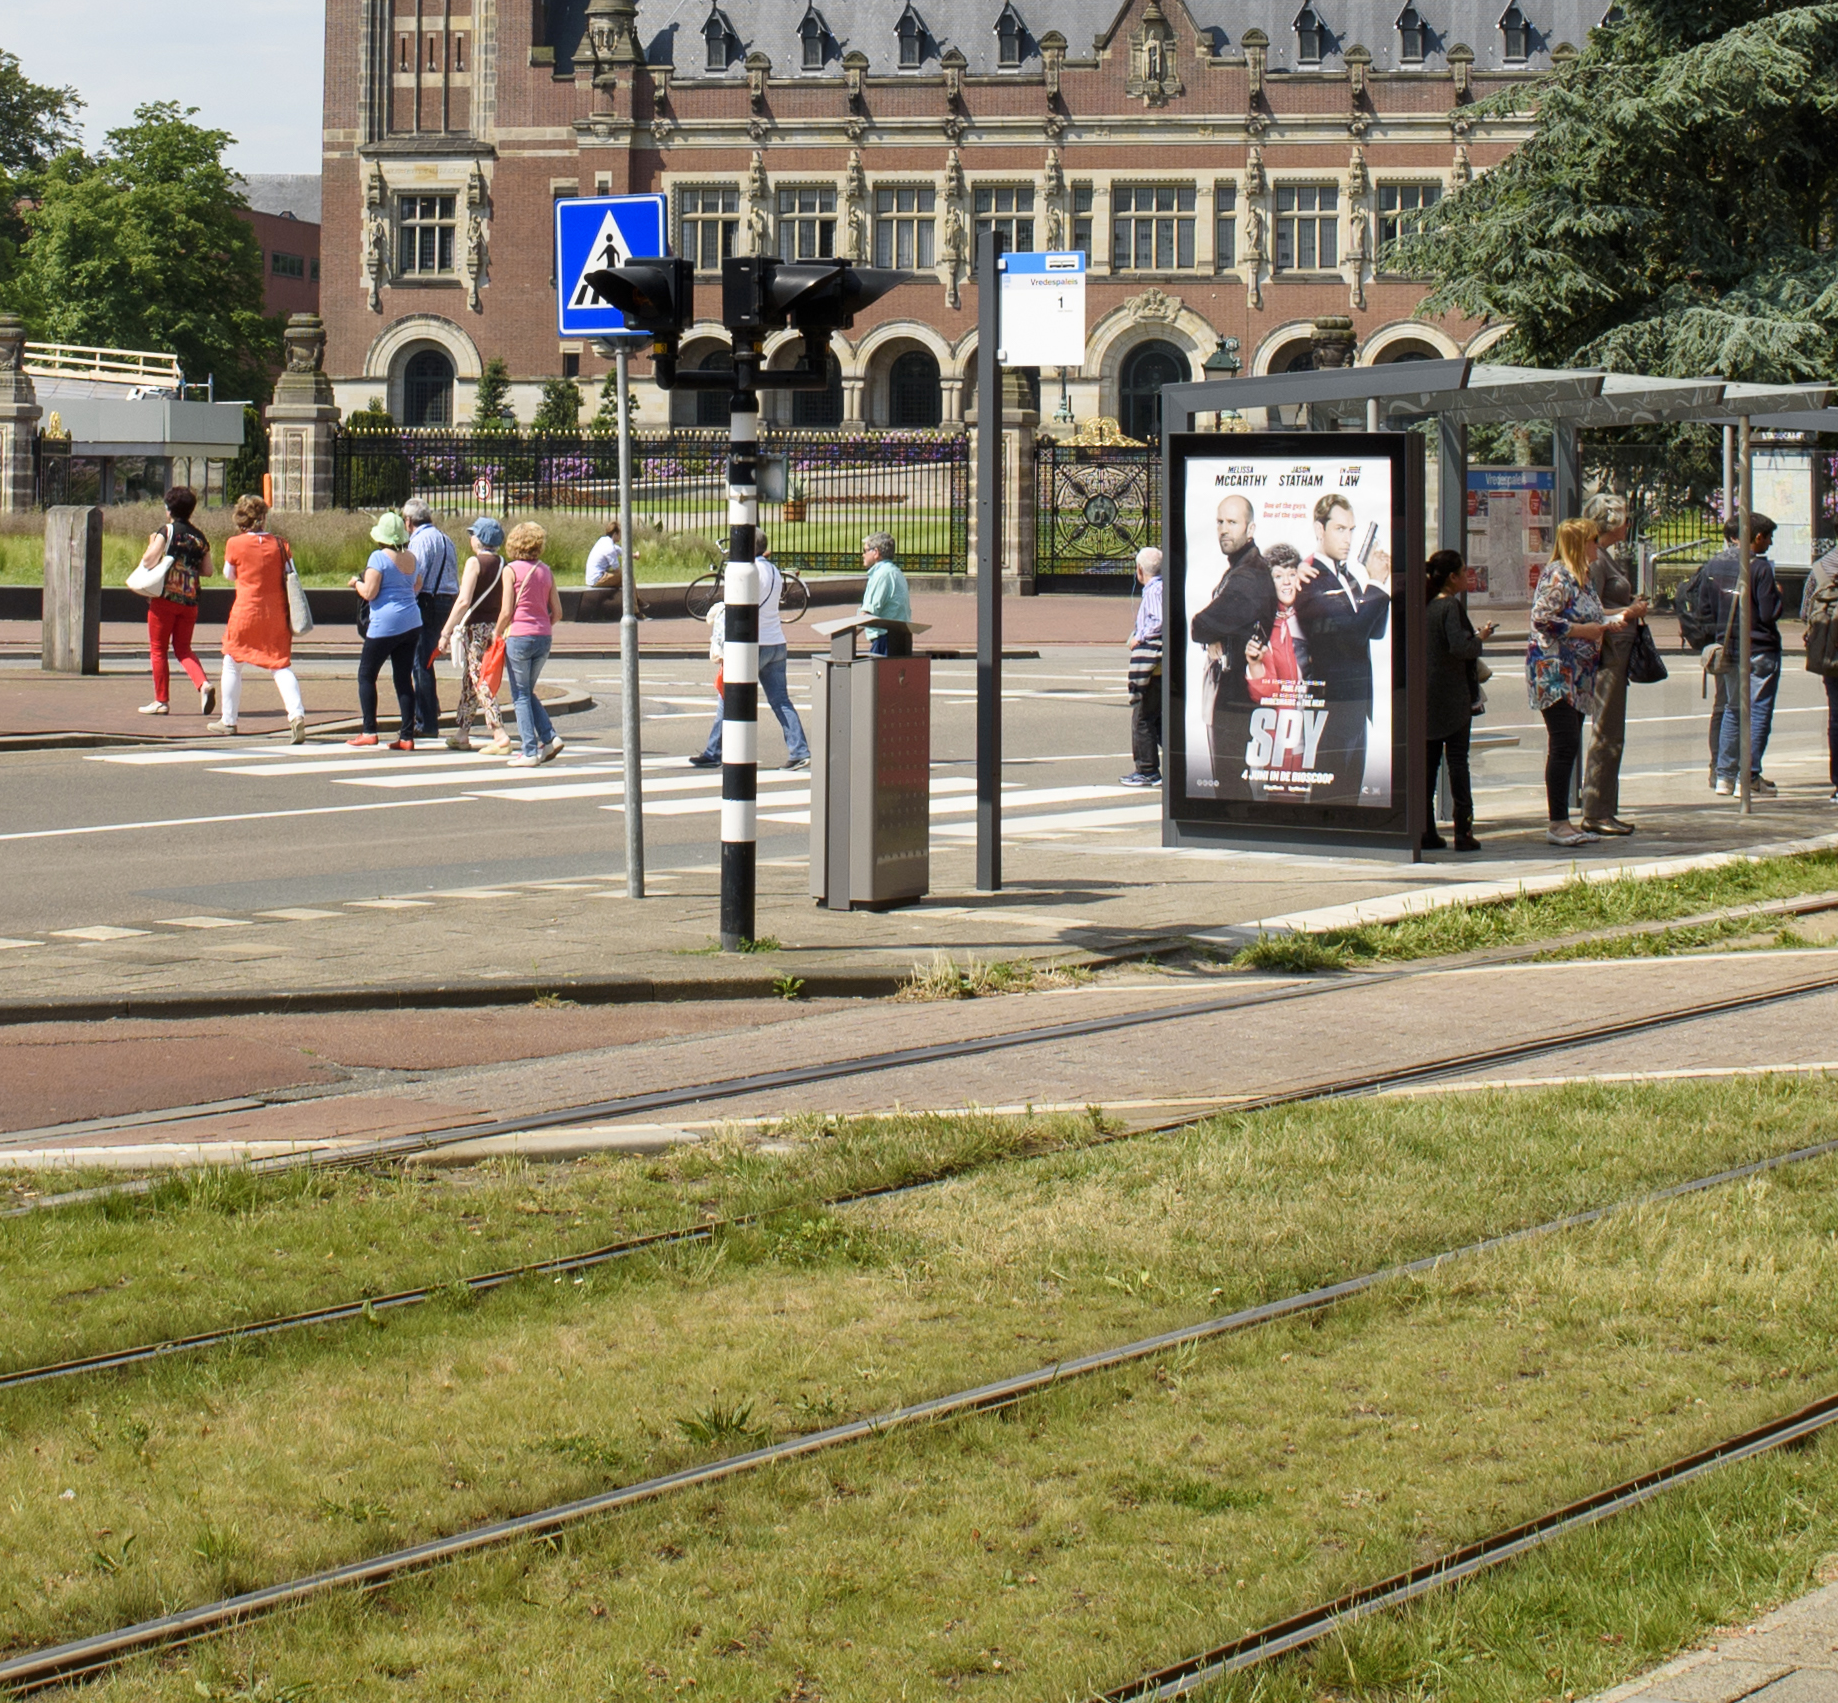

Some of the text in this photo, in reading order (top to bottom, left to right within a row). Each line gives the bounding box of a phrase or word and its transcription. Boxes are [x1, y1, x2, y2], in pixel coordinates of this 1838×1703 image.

[1030, 278, 1079, 287] Vredespaleis
[1057, 296, 1064, 308] 1
[1227, 466, 1254, 474] MELISSA
[1291, 466, 1311, 474] JASON
[1278, 475, 1324, 487] STATHAM
[1339, 475, 1360, 487] LAW
[1245, 708, 1329, 769] SPY
[1241, 769, 1335, 785] 4 JUNI IN DE BIOSCOOP
